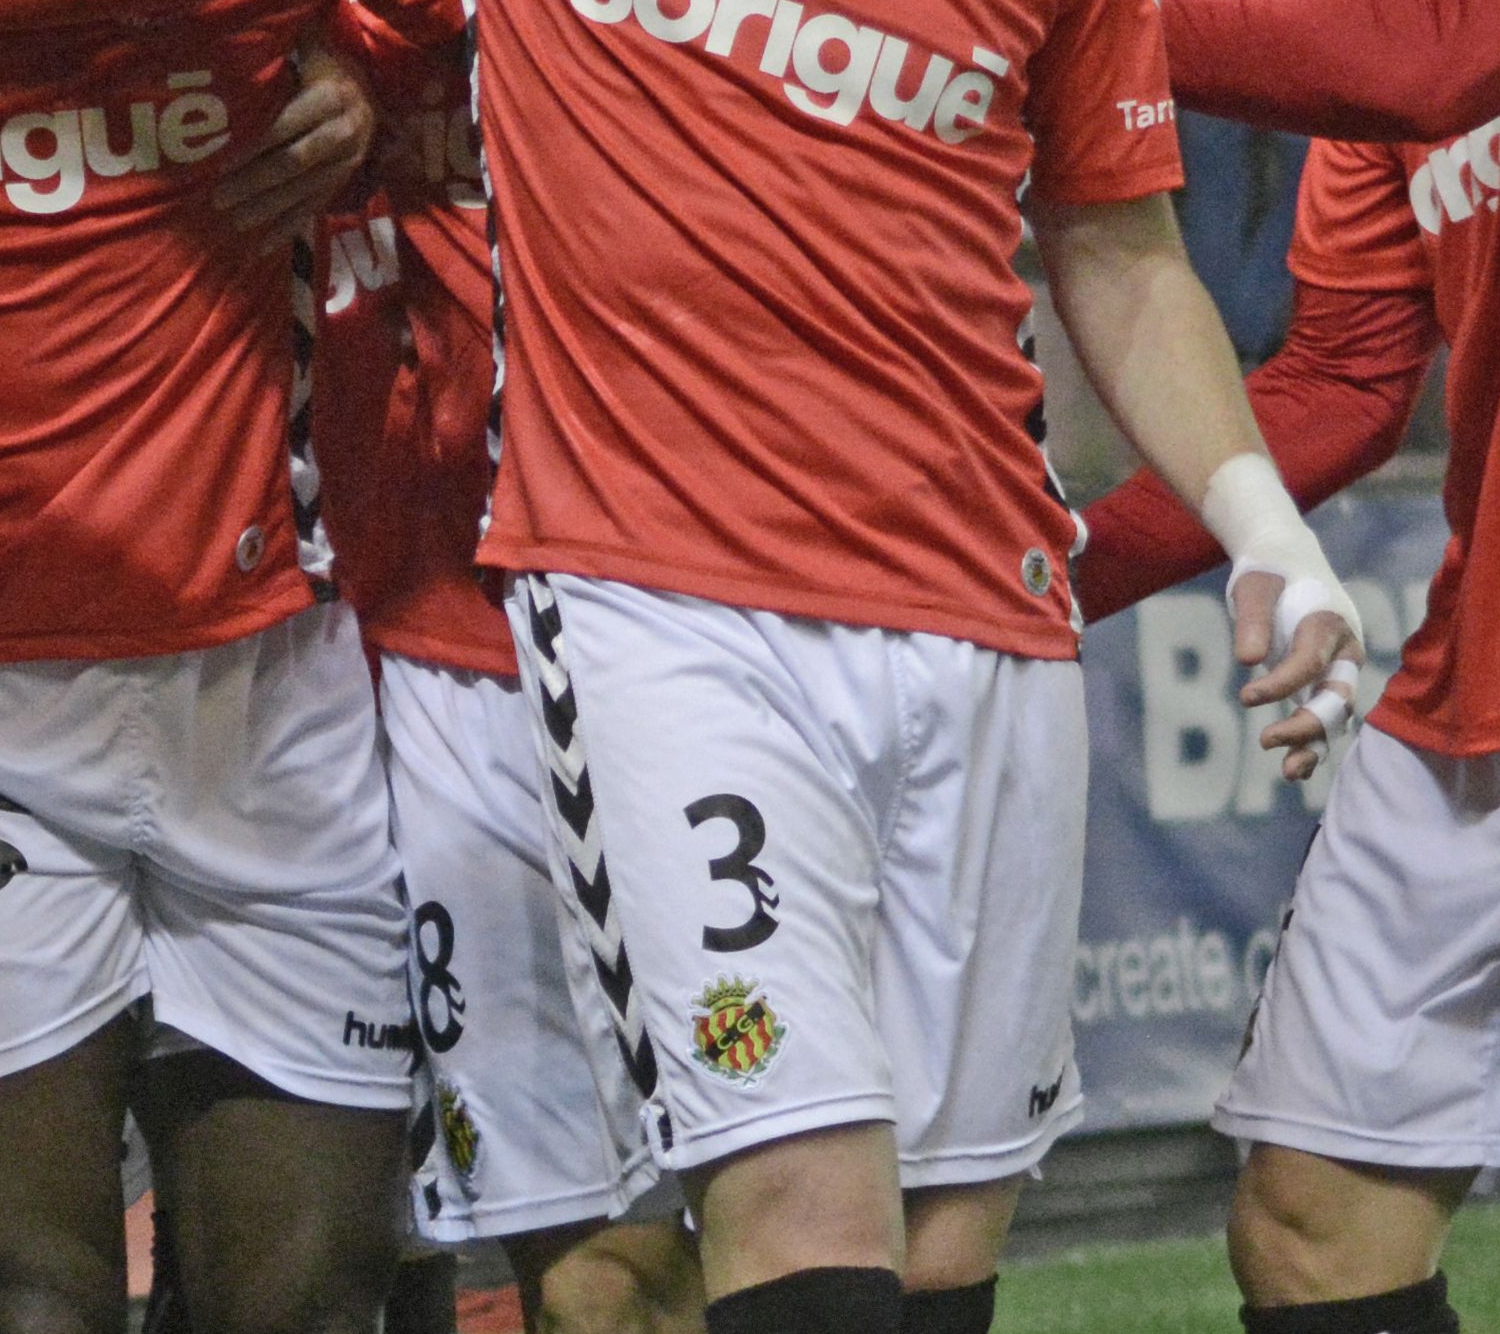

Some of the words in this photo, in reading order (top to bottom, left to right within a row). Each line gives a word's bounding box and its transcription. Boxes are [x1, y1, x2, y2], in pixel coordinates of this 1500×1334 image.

[682, 792, 781, 954] 3
[414, 899, 467, 1054] 8
[1068, 914, 1234, 1023] create
